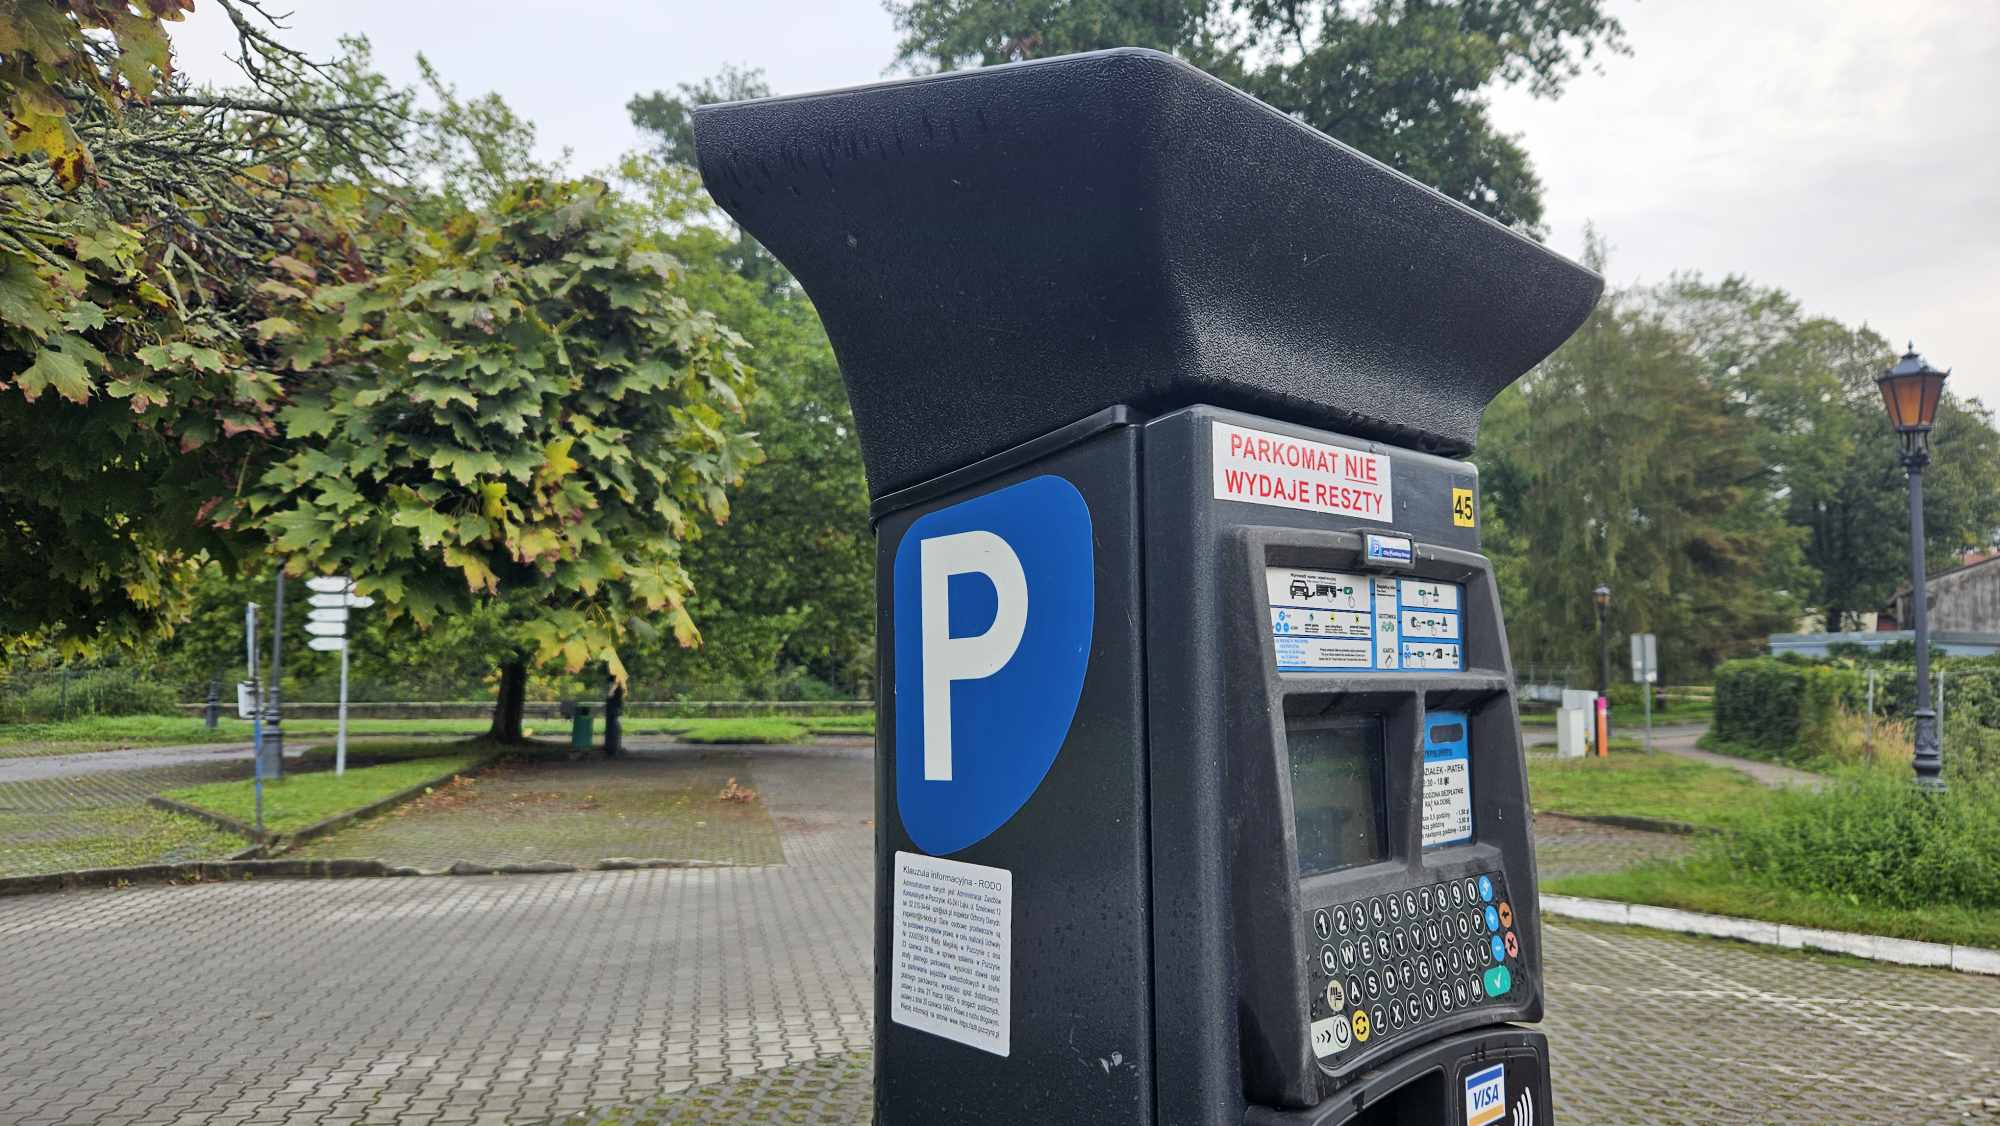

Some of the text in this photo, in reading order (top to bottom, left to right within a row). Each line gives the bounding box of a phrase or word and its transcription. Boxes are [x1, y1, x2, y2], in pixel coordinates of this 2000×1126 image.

[1231, 434, 1377, 482] PARKOMAT NIE
[1226, 469, 1383, 514] WYDAJE RESZTY
[1454, 495, 1474, 520] 45
[920, 530, 1028, 781] P
[930, 870, 972, 886] informacyjna
[1319, 883, 1475, 934] 1 2 3 4 5 6 7 8 9 0
[1324, 951, 1335, 969] Q
[1341, 945, 1354, 964] W
[1362, 942, 1371, 959] E
[1379, 938, 1389, 954] R
[1396, 933, 1403, 950] T
[1413, 929, 1420, 945] Y
[1429, 926, 1437, 941] U
[1460, 918, 1467, 933] O
[1474, 914, 1481, 929] P
[1352, 945, 1488, 1000] A S D F G H J K L
[1375, 980, 1481, 1028] Z X C V B N M
[1474, 1084, 1499, 1110] VISA
